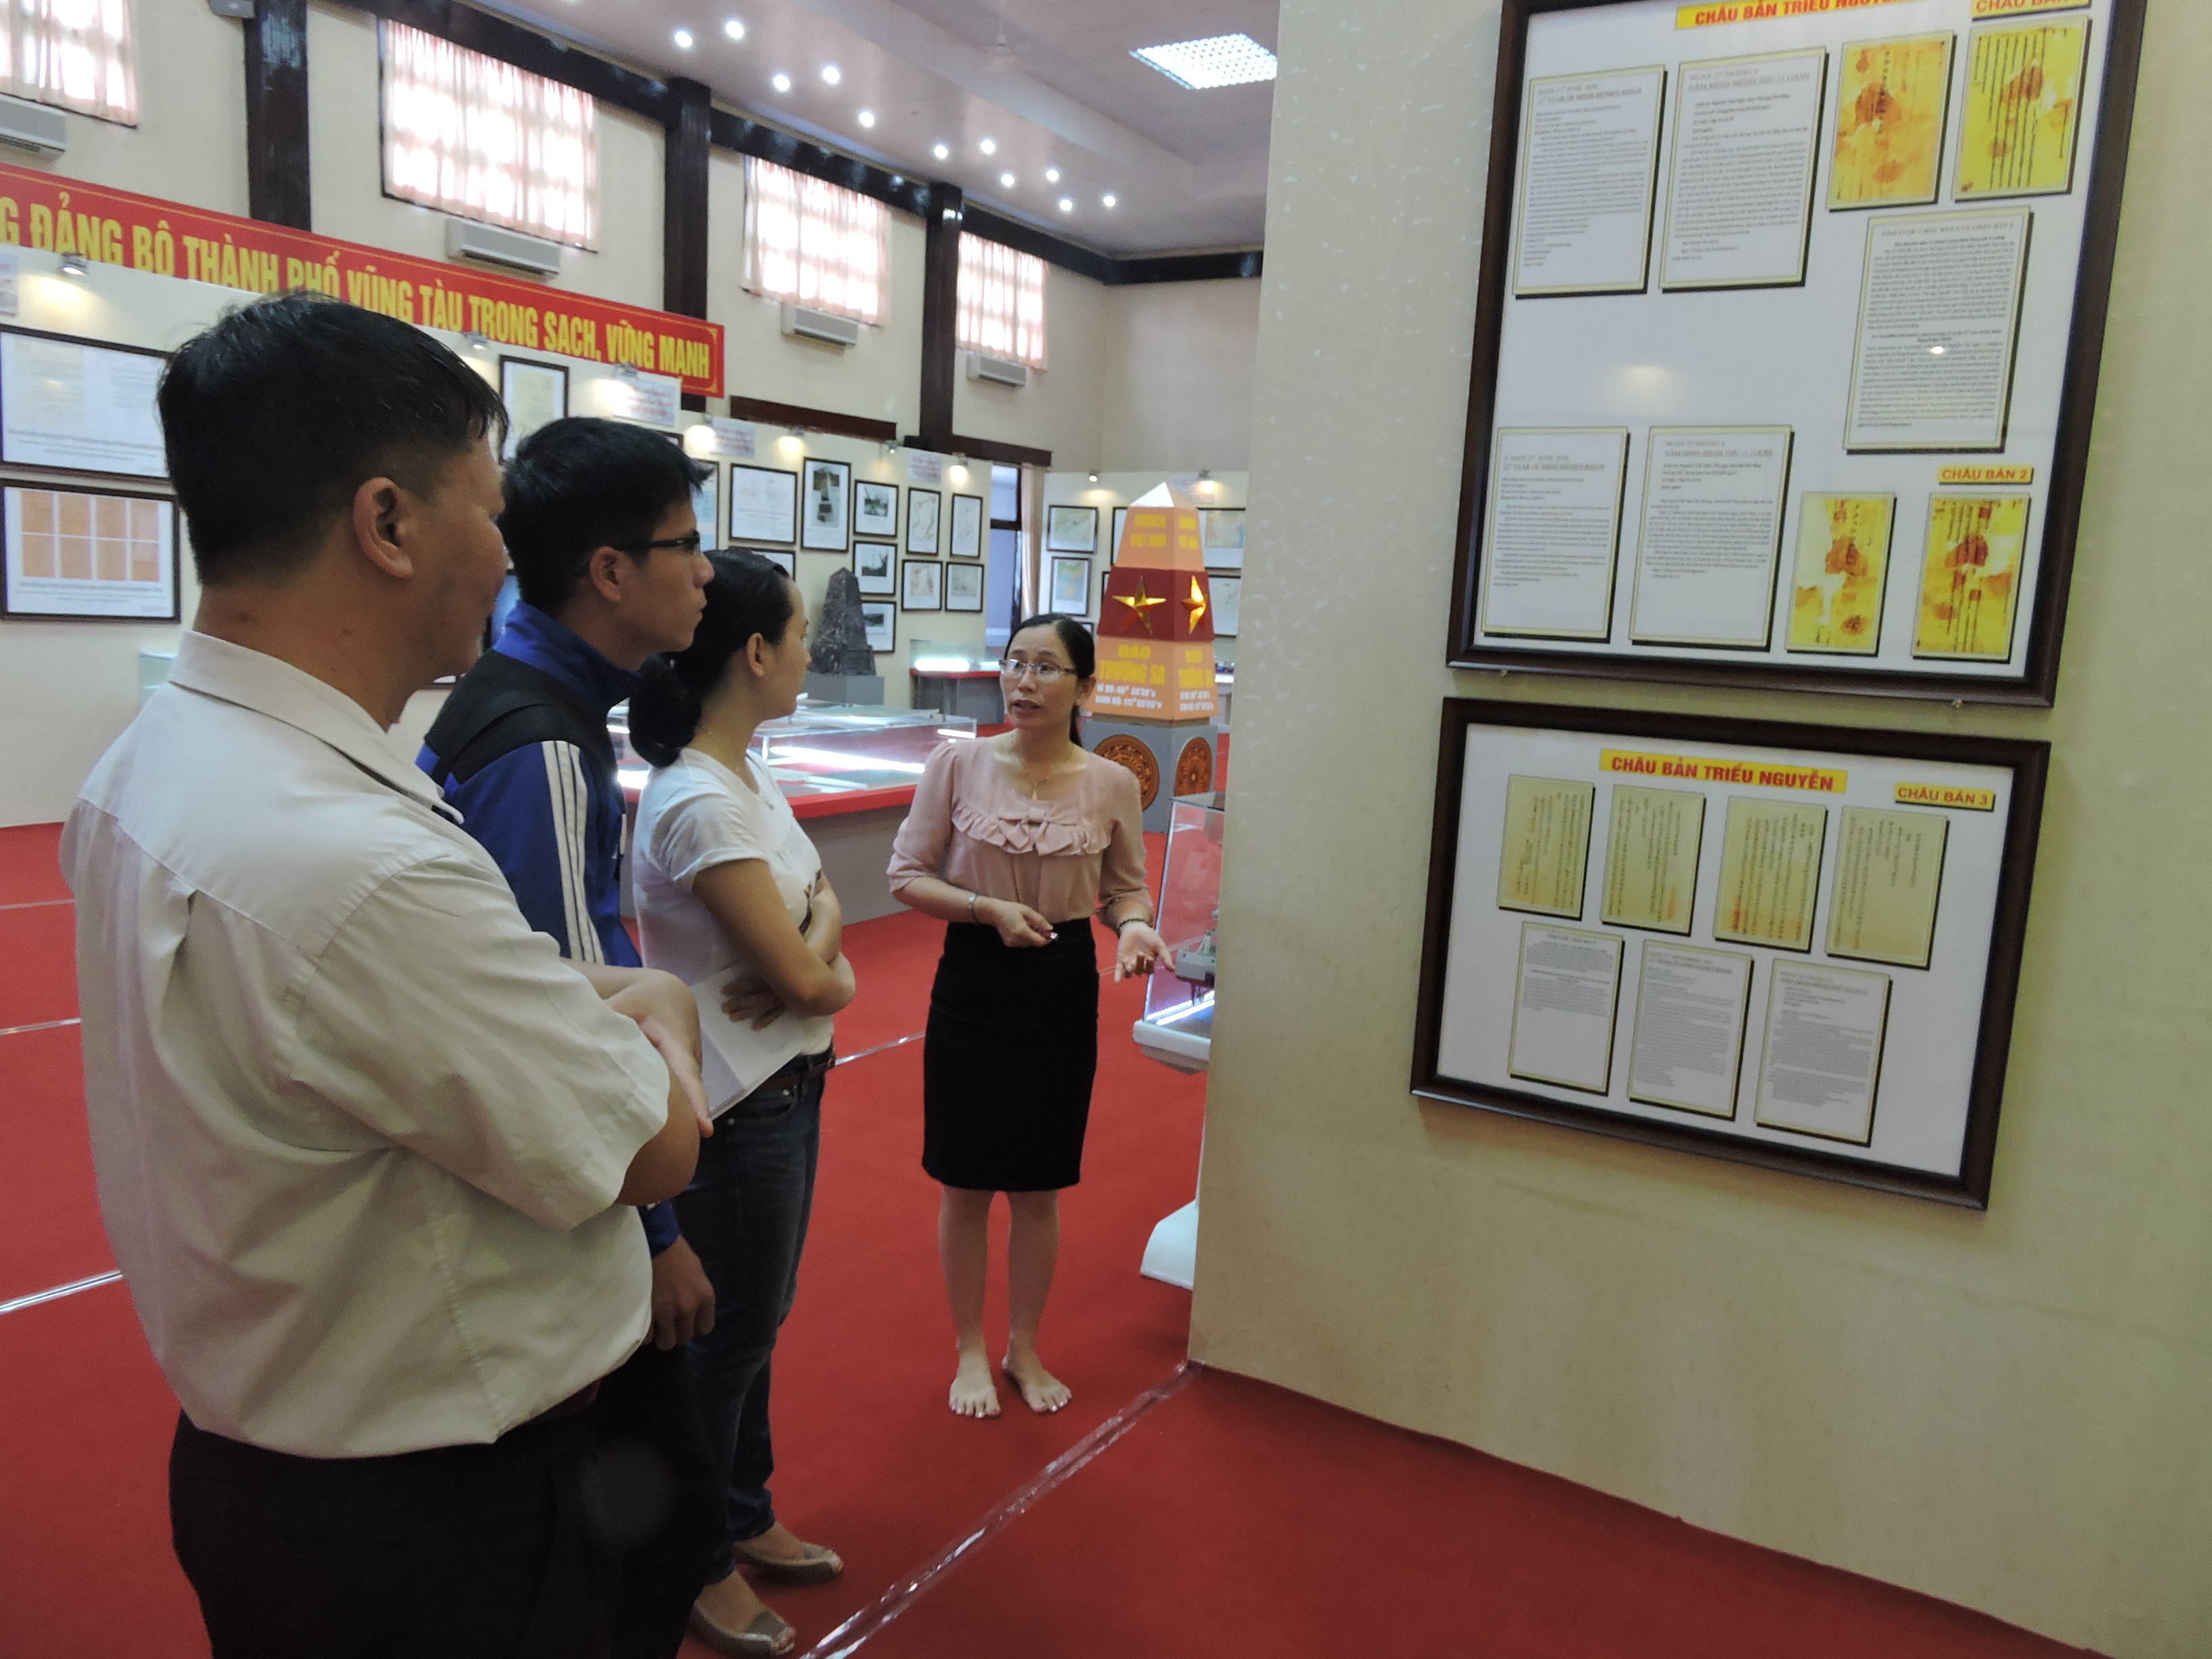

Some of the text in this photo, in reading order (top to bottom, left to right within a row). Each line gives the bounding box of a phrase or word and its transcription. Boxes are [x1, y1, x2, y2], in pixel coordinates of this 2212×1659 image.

[30, 191, 124, 265] ĐẢNG
[182, 234, 279, 294] THÀNH
[287, 251, 341, 298] PHỐ
[347, 265, 415, 323] VŨNG
[419, 279, 463, 332] TÀU
[468, 295, 539, 348] TRONG
[2020, 469, 2028, 480] 2
[1612, 756, 1658, 774] CHÂU
[1662, 756, 1698, 778] BẢN
[1981, 794, 1988, 805] 3
